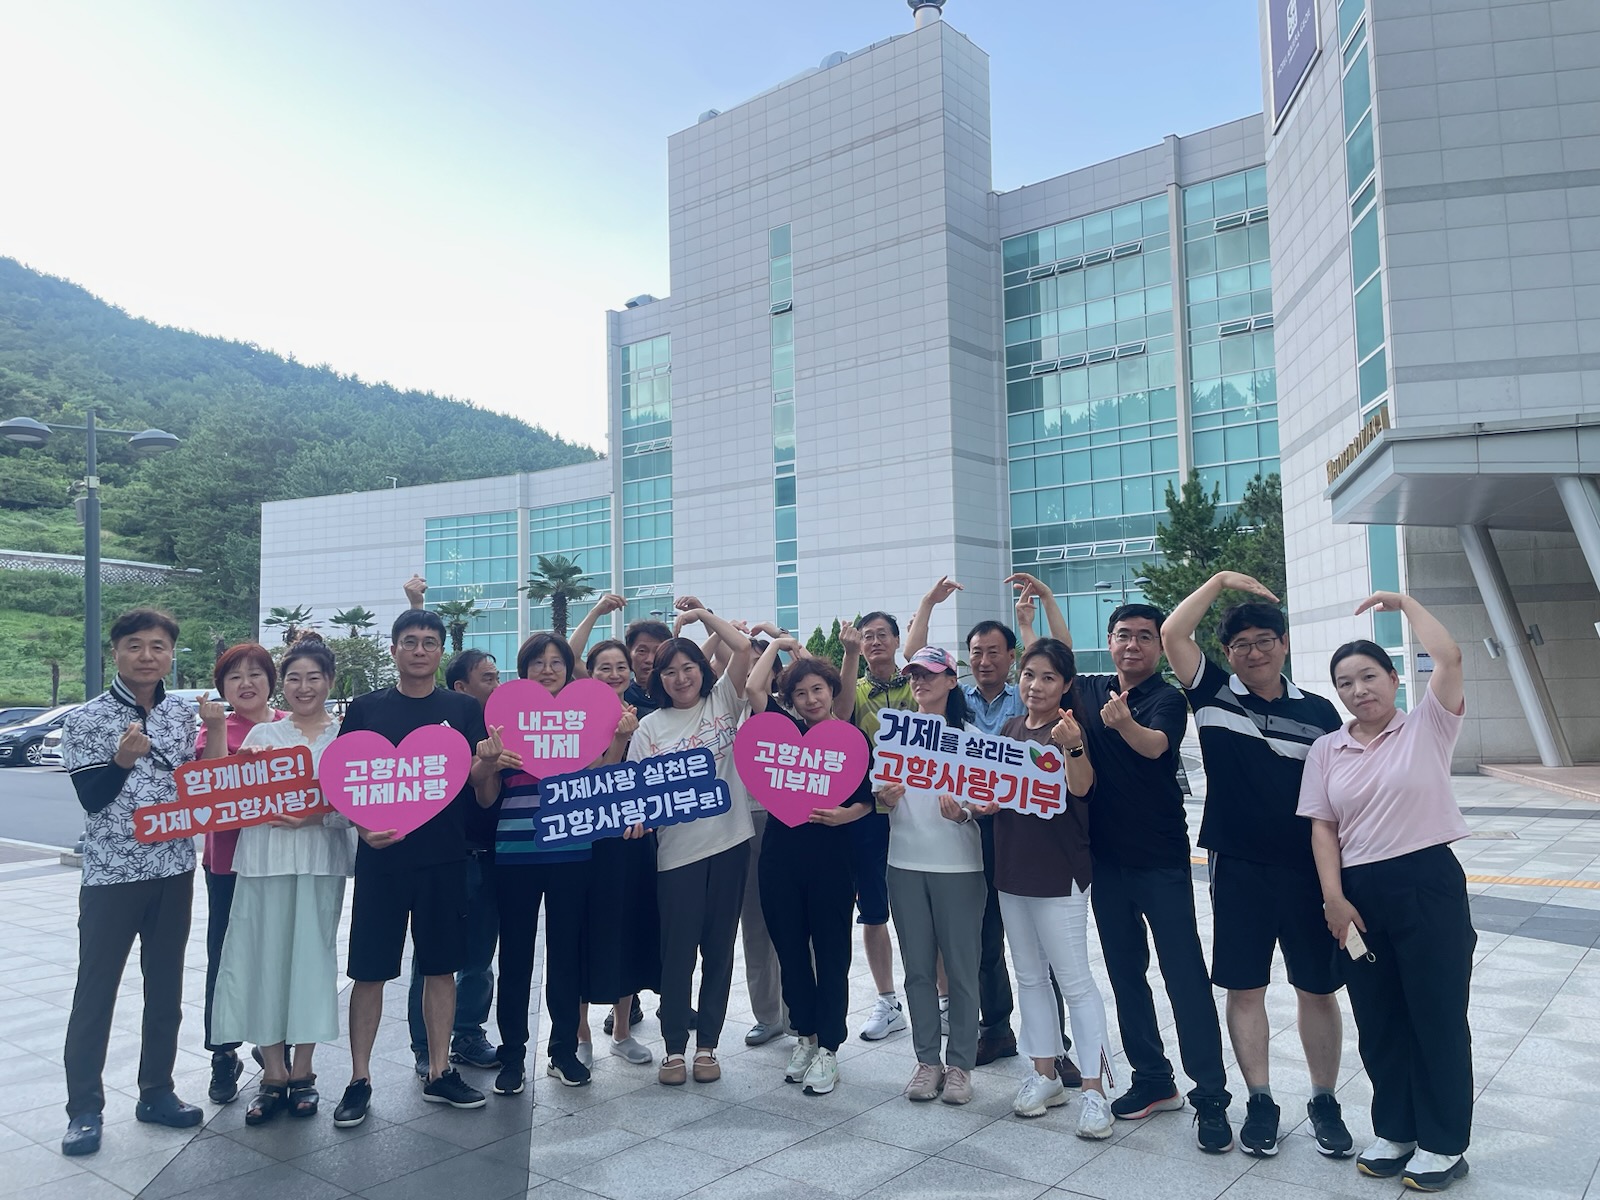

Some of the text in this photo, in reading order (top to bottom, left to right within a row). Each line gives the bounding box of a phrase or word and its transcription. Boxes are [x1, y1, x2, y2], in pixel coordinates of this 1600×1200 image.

[518, 710, 587, 731] 내고향
[523, 733, 580, 759] 거제
[879, 713, 1025, 767] 거제를 살리는
[344, 754, 448, 782] 고향사랑
[753, 741, 847, 773] 고향사랑
[183, 753, 306, 797] 함께해요!
[546, 753, 710, 805] 거제사랑 실천은
[764, 766, 831, 796] 기부제
[874, 750, 1062, 814] 고향사랑기부
[343, 779, 448, 806] 거제사랑
[540, 786, 725, 842] 고향사랑기부로!
